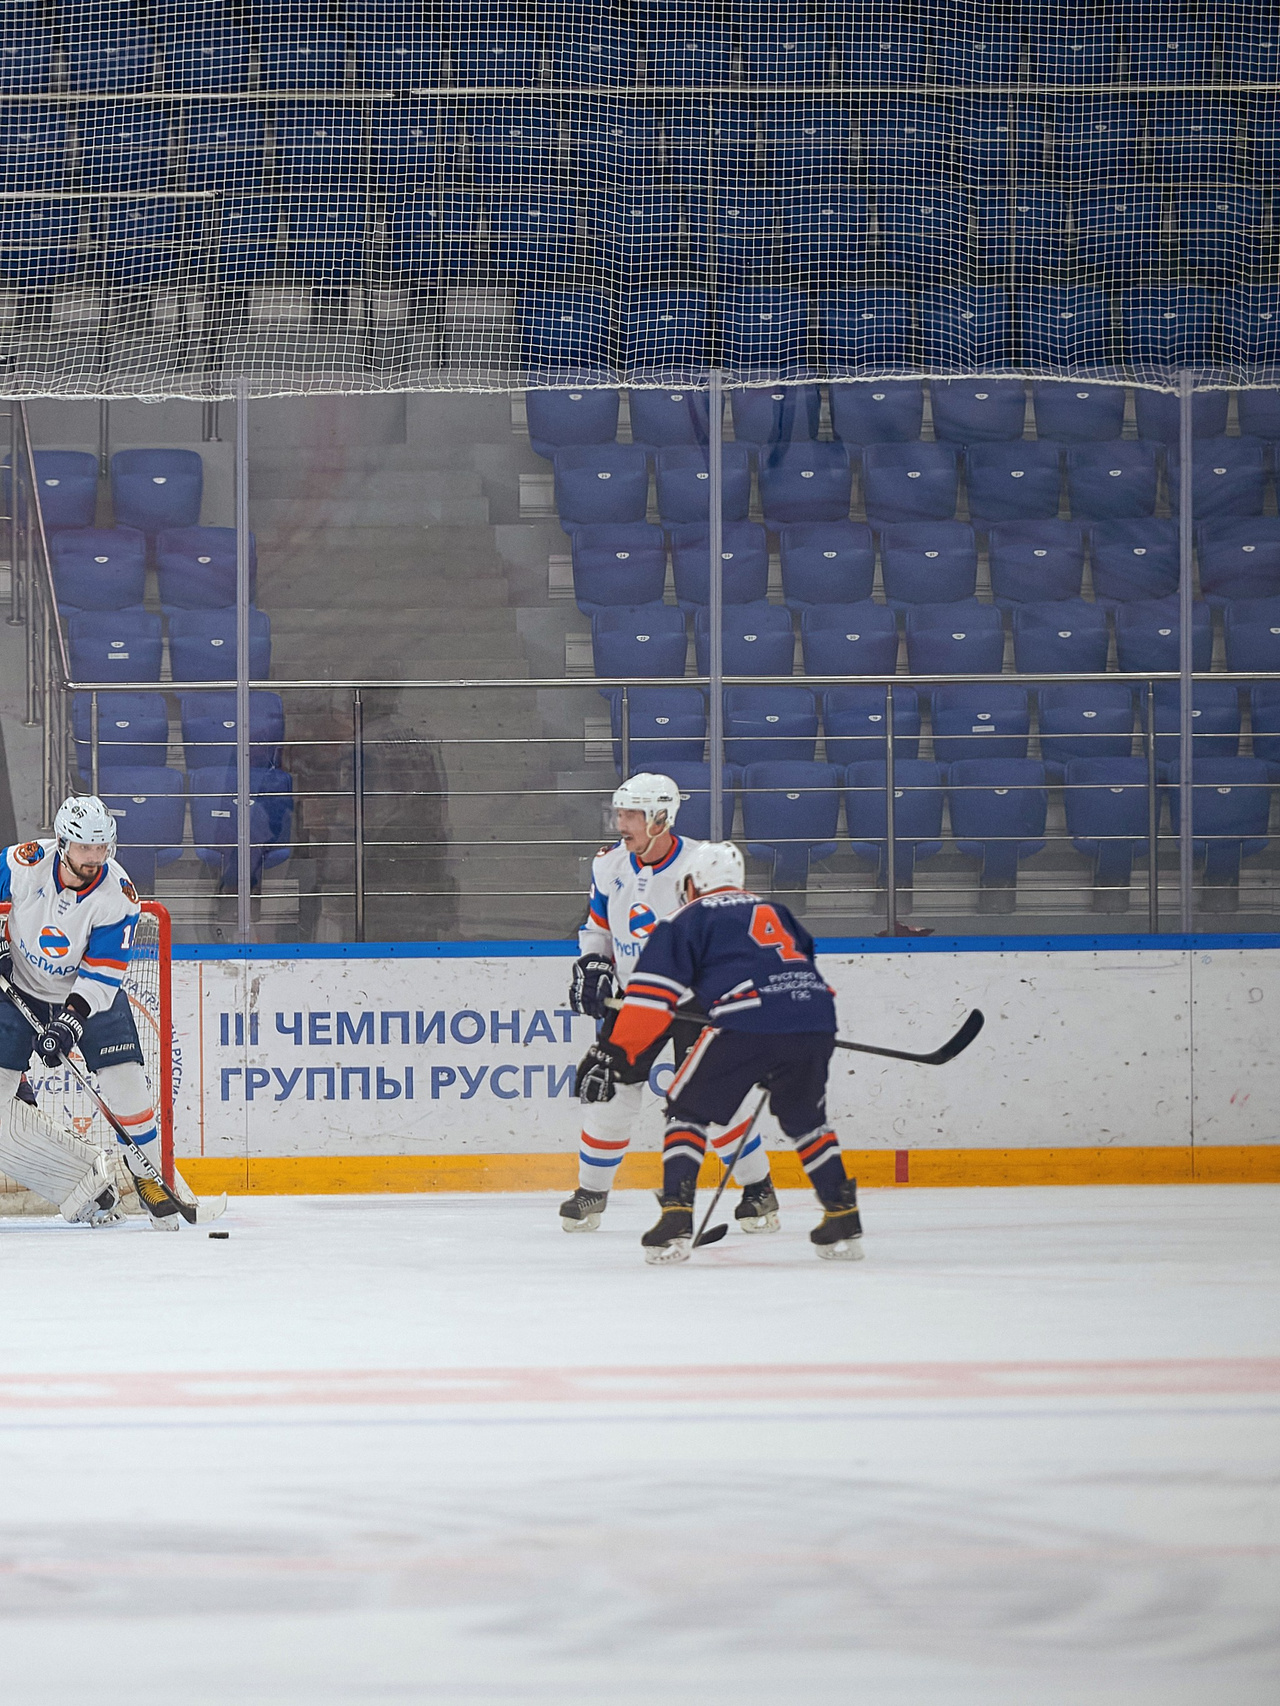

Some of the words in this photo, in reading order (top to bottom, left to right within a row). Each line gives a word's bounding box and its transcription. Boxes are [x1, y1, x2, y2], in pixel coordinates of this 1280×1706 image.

[121, 924, 138, 949] 1
[748, 903, 808, 963] 4
[19, 938, 76, 977] РусГидр
[275, 1009, 581, 1046] ЧЕМПИОНАТ
[220, 1066, 414, 1102] ГРУППЫ
[430, 1064, 676, 1100] РУСГИО
